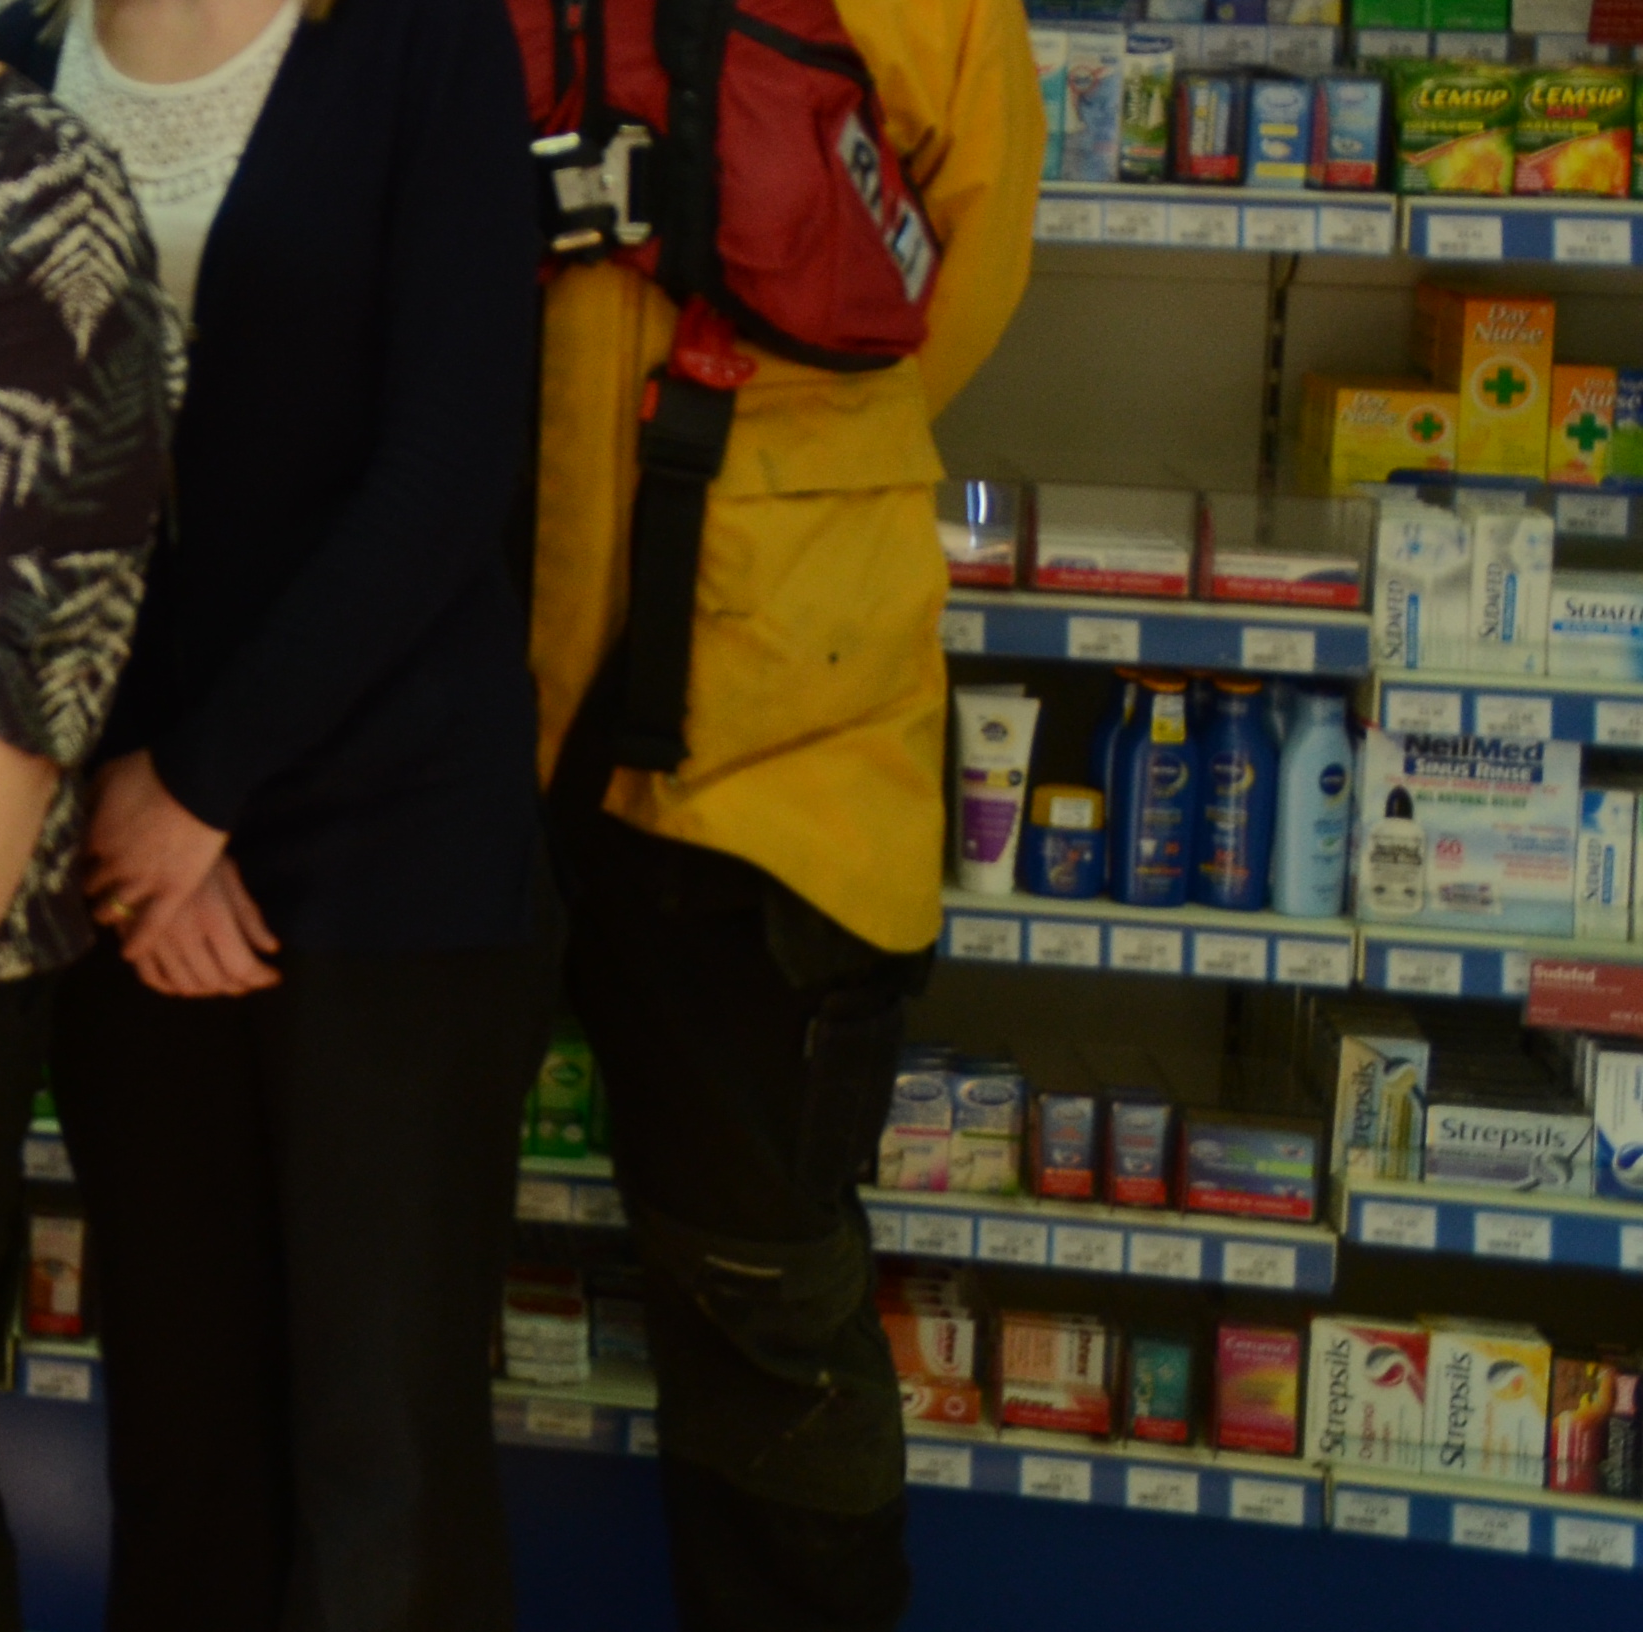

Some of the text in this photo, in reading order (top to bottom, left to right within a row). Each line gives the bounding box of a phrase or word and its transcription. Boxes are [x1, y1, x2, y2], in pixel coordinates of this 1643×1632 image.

[1419, 87, 1510, 108] LEMSIP
[1532, 84, 1624, 105] LEMSIP
[1488, 303, 1531, 324] Day
[1473, 322, 1543, 344] Nurse
[1479, 561, 1503, 640] SUDAFED
[1385, 578, 1405, 662] SUDAFED
[1406, 734, 1545, 765] NeilMed
[1440, 1116, 1567, 1151] Strepsils
[1319, 1336, 1353, 1458] Strepsils
[1439, 1350, 1475, 1470] Strepsils
